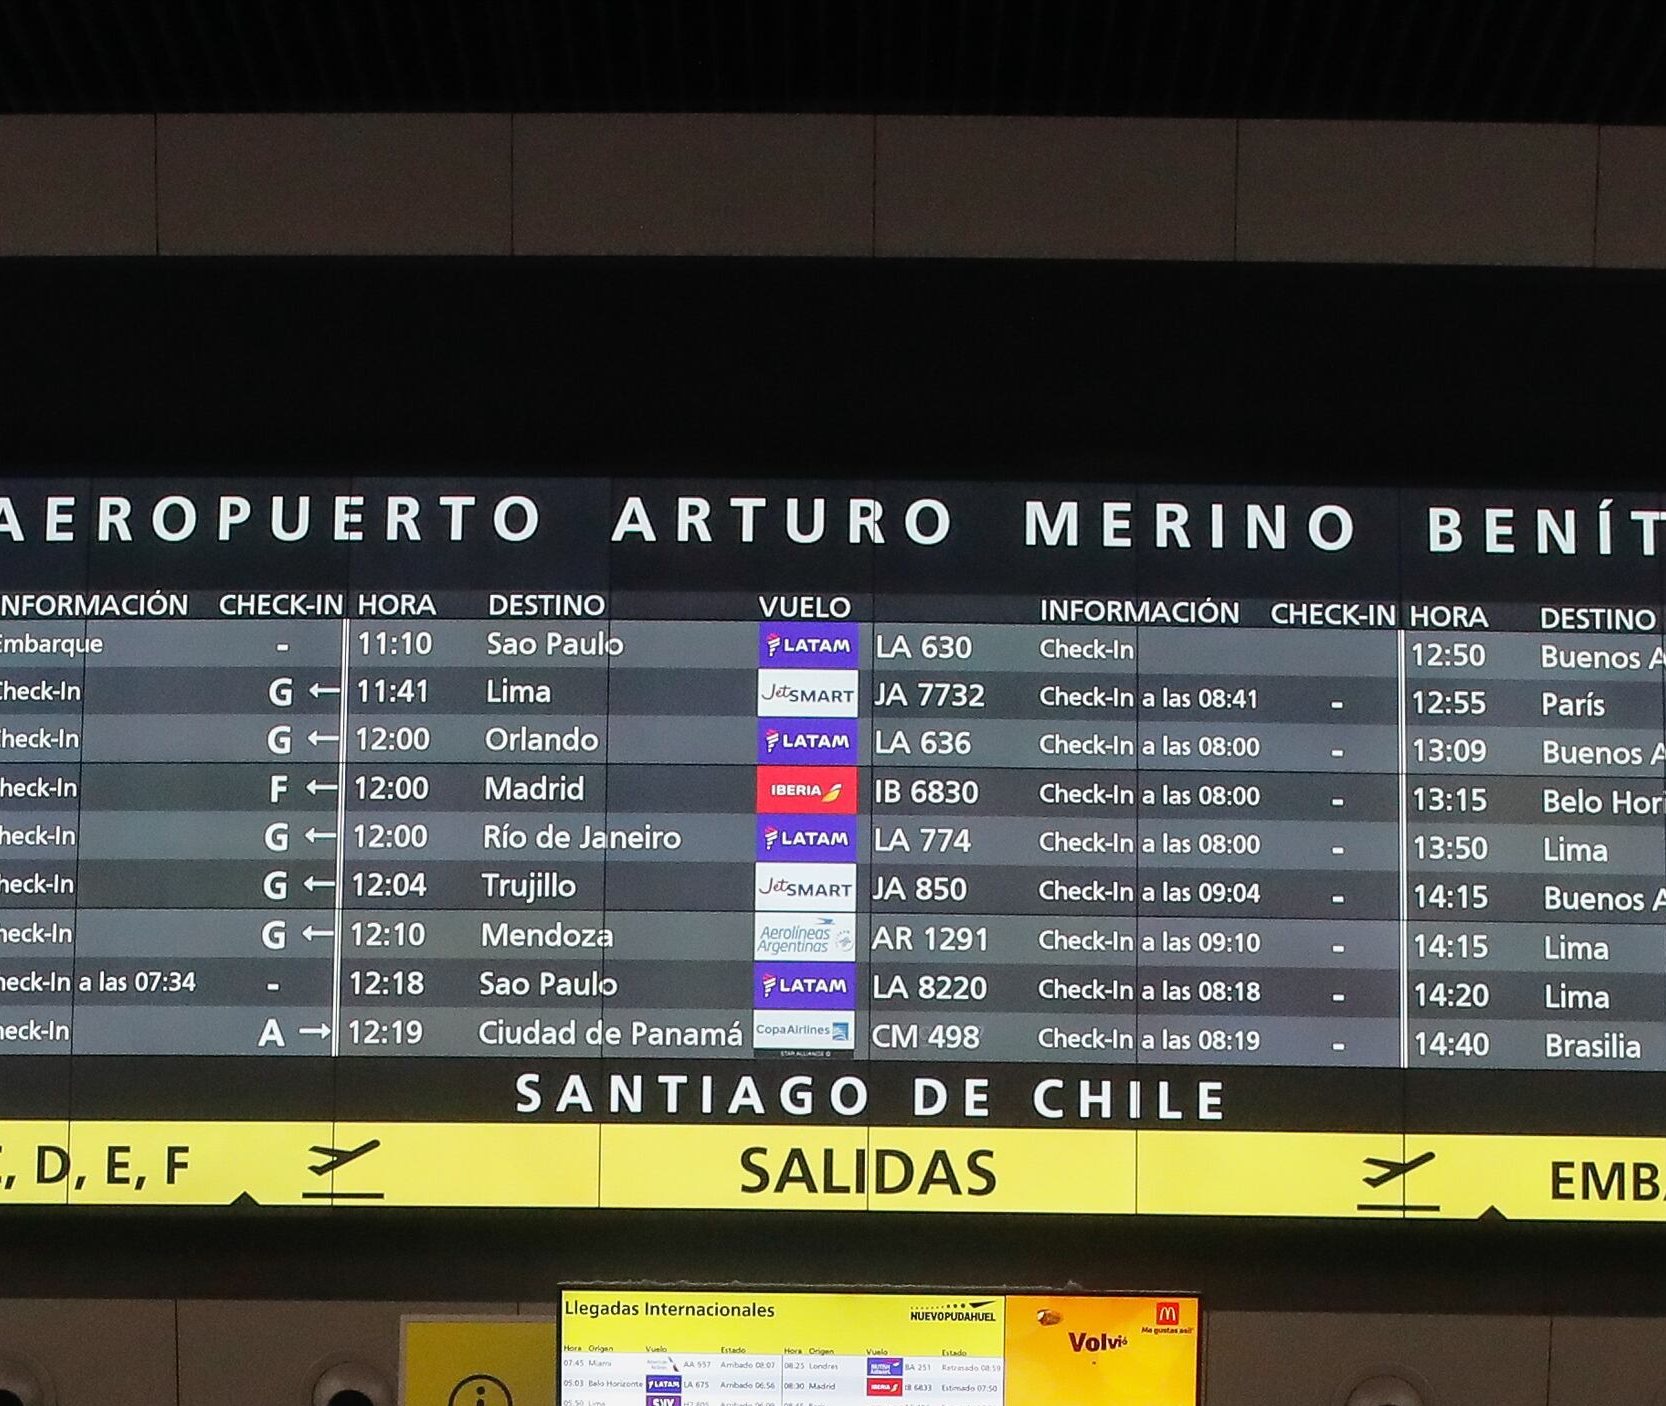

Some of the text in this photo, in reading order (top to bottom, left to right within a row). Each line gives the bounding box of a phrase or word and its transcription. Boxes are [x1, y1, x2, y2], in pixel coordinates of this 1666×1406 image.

[611, 496, 950, 545] ARTURO
[1025, 501, 1353, 551] MERINO
[219, 594, 343, 616] CHECK-IN
[358, 630, 1134, 660] 11:10 Sao Paulo LATAM LA 630 Check-In
[355, 775, 1261, 806] 12:00 Madrid IBERIA IB 6830 Check-In a las 08:00
[1414, 835, 1488, 860] 13:50
[1544, 835, 1608, 862] Lima
[257, 1018, 285, 1047] A
[516, 1073, 1223, 1120] SANTIAGO DE CHILE
[36, 1146, 87, 1190] D,
[107, 1145, 146, 1190] E,
[166, 1146, 189, 1185] F
[740, 1146, 996, 1196] SALIDAS
[564, 1300, 775, 1318] Llegadas Internacionales
[910, 1311, 997, 1323] NUEVOPUDAHUEL
[1069, 1332, 1127, 1353] Volvió
